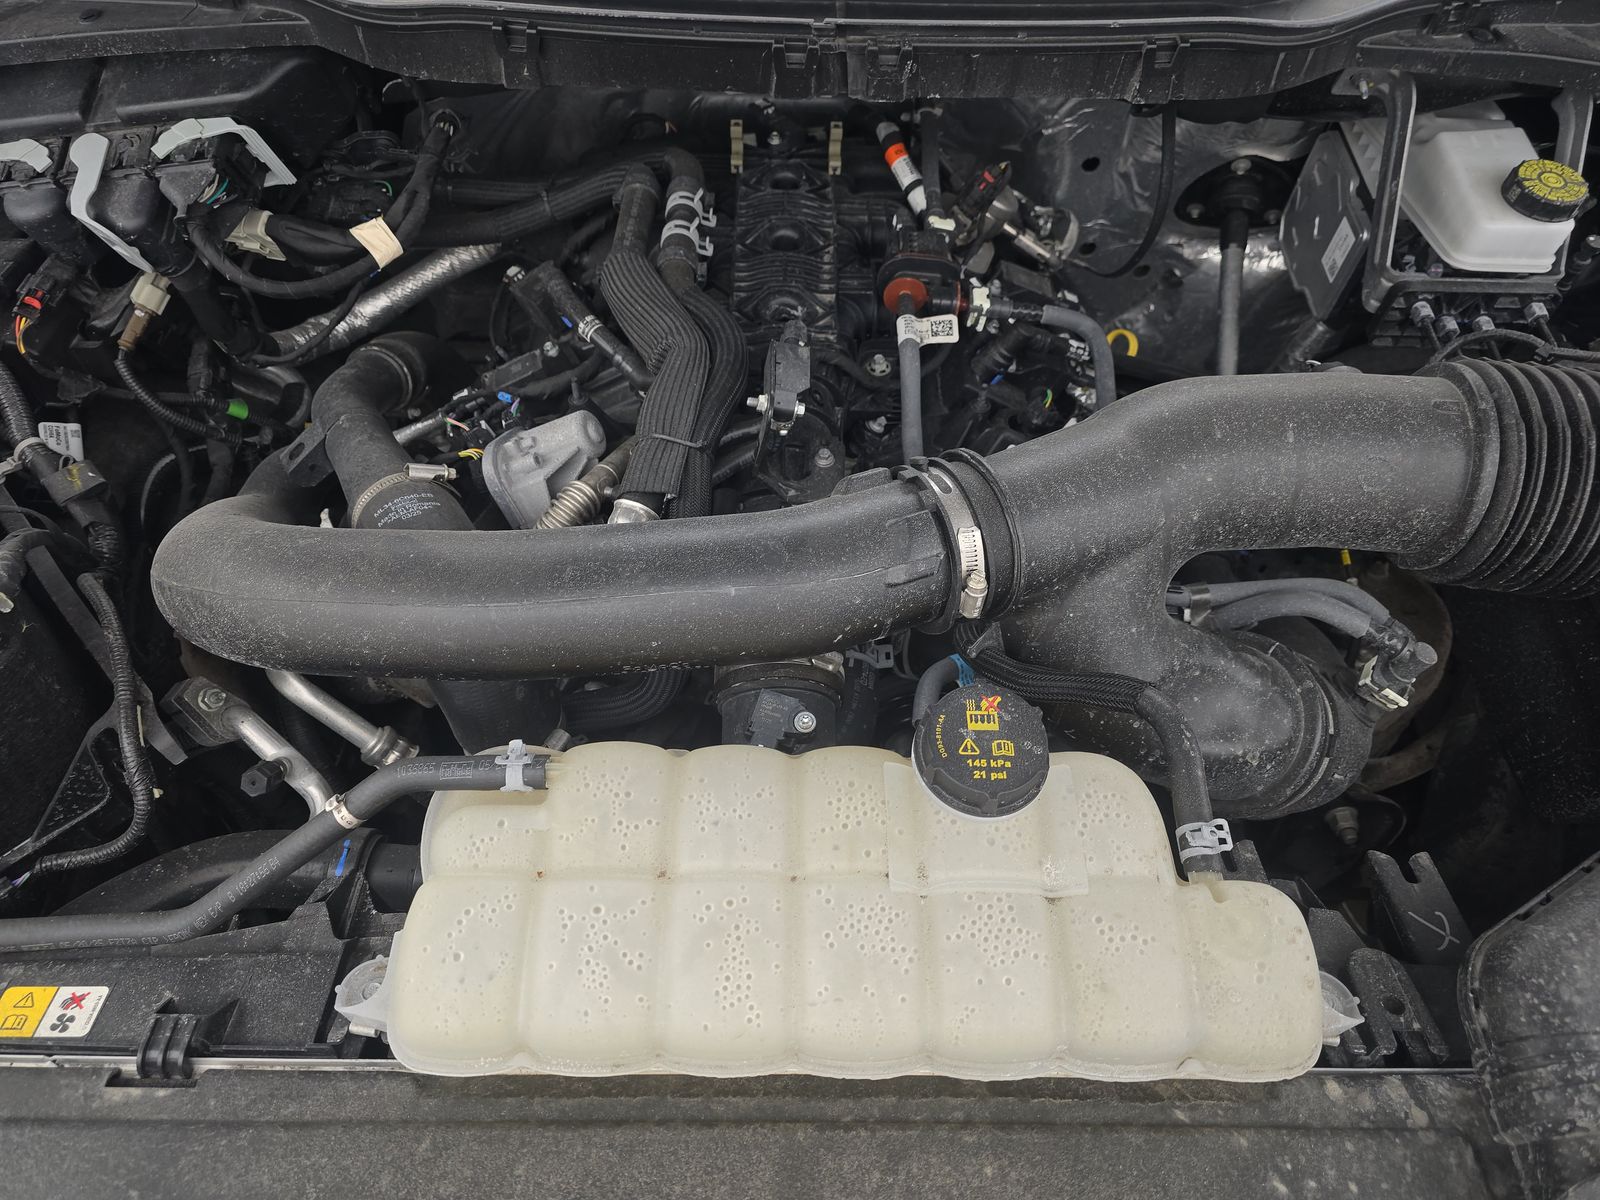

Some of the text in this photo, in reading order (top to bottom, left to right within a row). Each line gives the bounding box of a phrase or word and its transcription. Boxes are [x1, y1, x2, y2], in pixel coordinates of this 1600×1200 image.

[966, 758, 1012, 768] 145 kPa
[973, 770, 1008, 781] 21 psi
